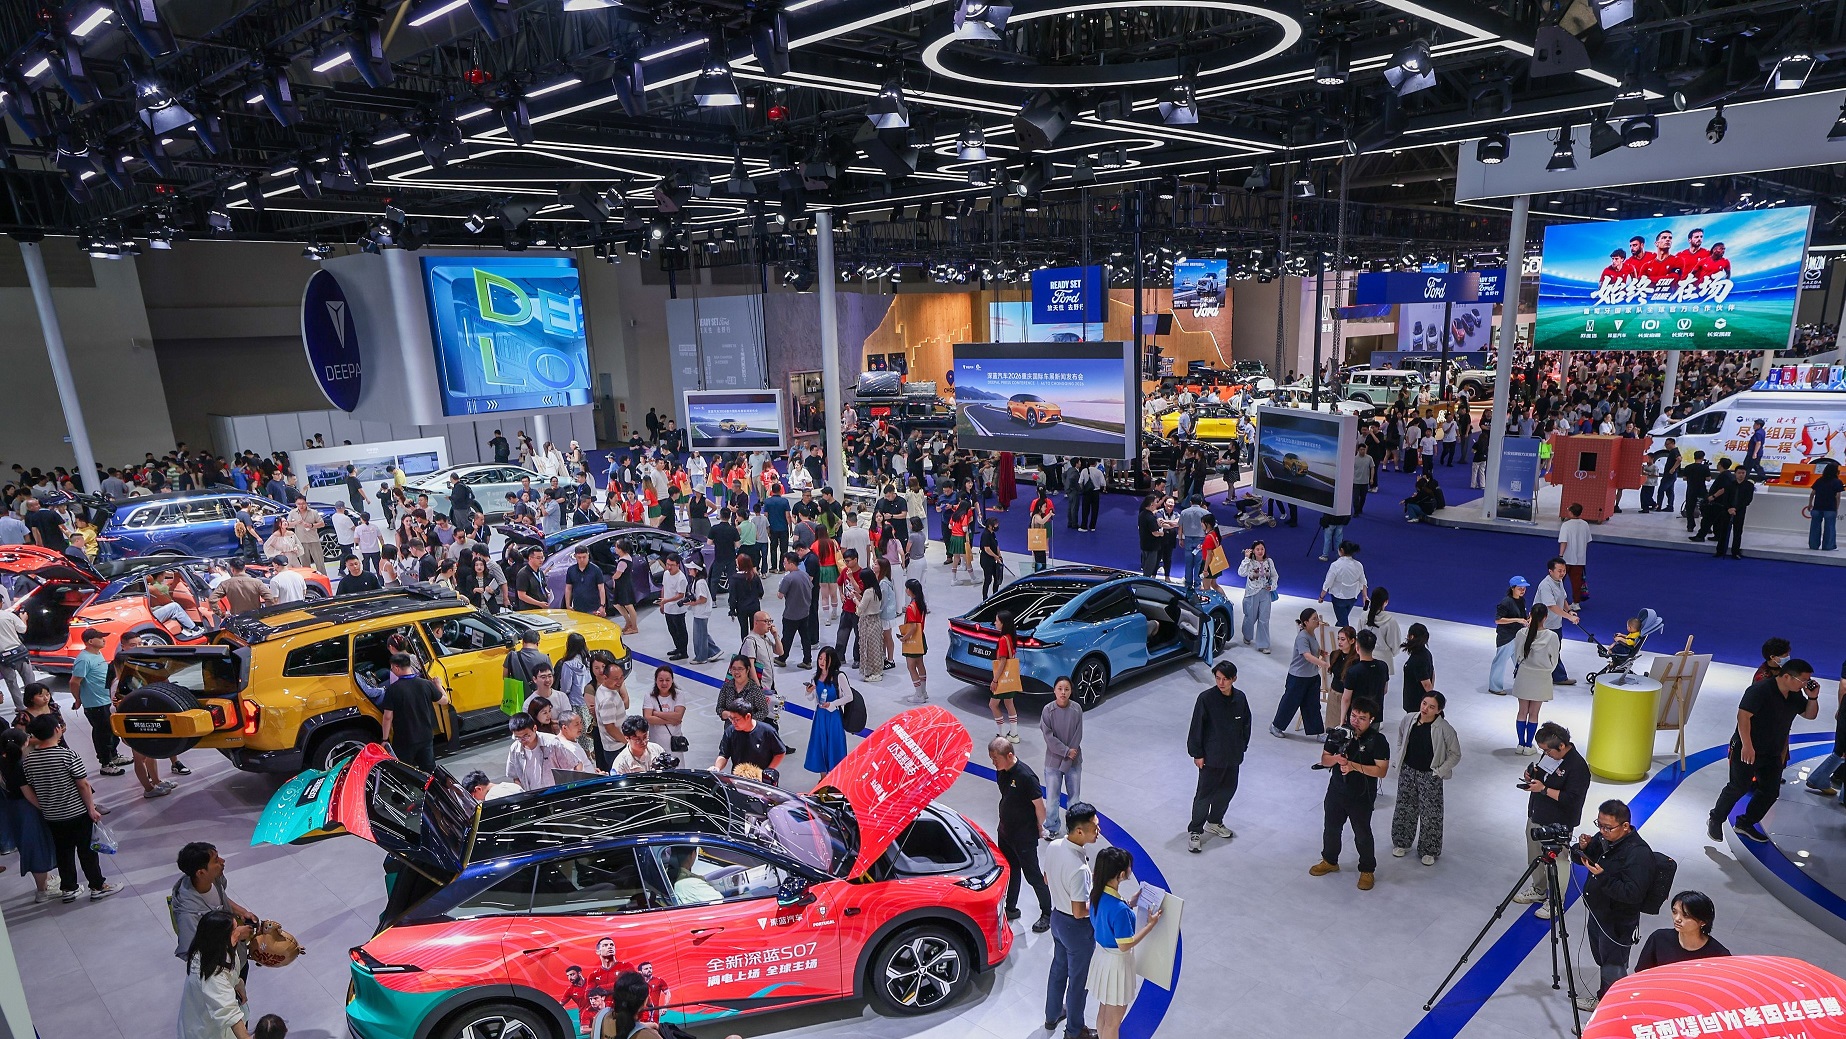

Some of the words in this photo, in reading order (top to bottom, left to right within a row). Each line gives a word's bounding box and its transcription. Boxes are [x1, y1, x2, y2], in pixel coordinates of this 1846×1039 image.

[1050, 281, 1069, 290] READY
[1070, 280, 1081, 288] SET
[1424, 276, 1446, 298] Ford
[1590, 275, 1656, 308] 始终
[1667, 270, 1734, 304] 在场
[1656, 278, 1674, 286] STAY
[1052, 290, 1080, 304] Ford
[1816, 370, 1822, 378] 7
[1736, 426, 1797, 440] 尽组局
[1724, 440, 1794, 453] 得胜一程
[886, 742, 920, 776] 全新深蓝S07
[770, 914, 804, 927] 深蓝汽车
[812, 920, 836, 928] PORTUGAL
[706, 942, 818, 972] 全新深蓝S07
[707, 968, 760, 988] 满电上场
[766, 958, 818, 976] 全球主场
